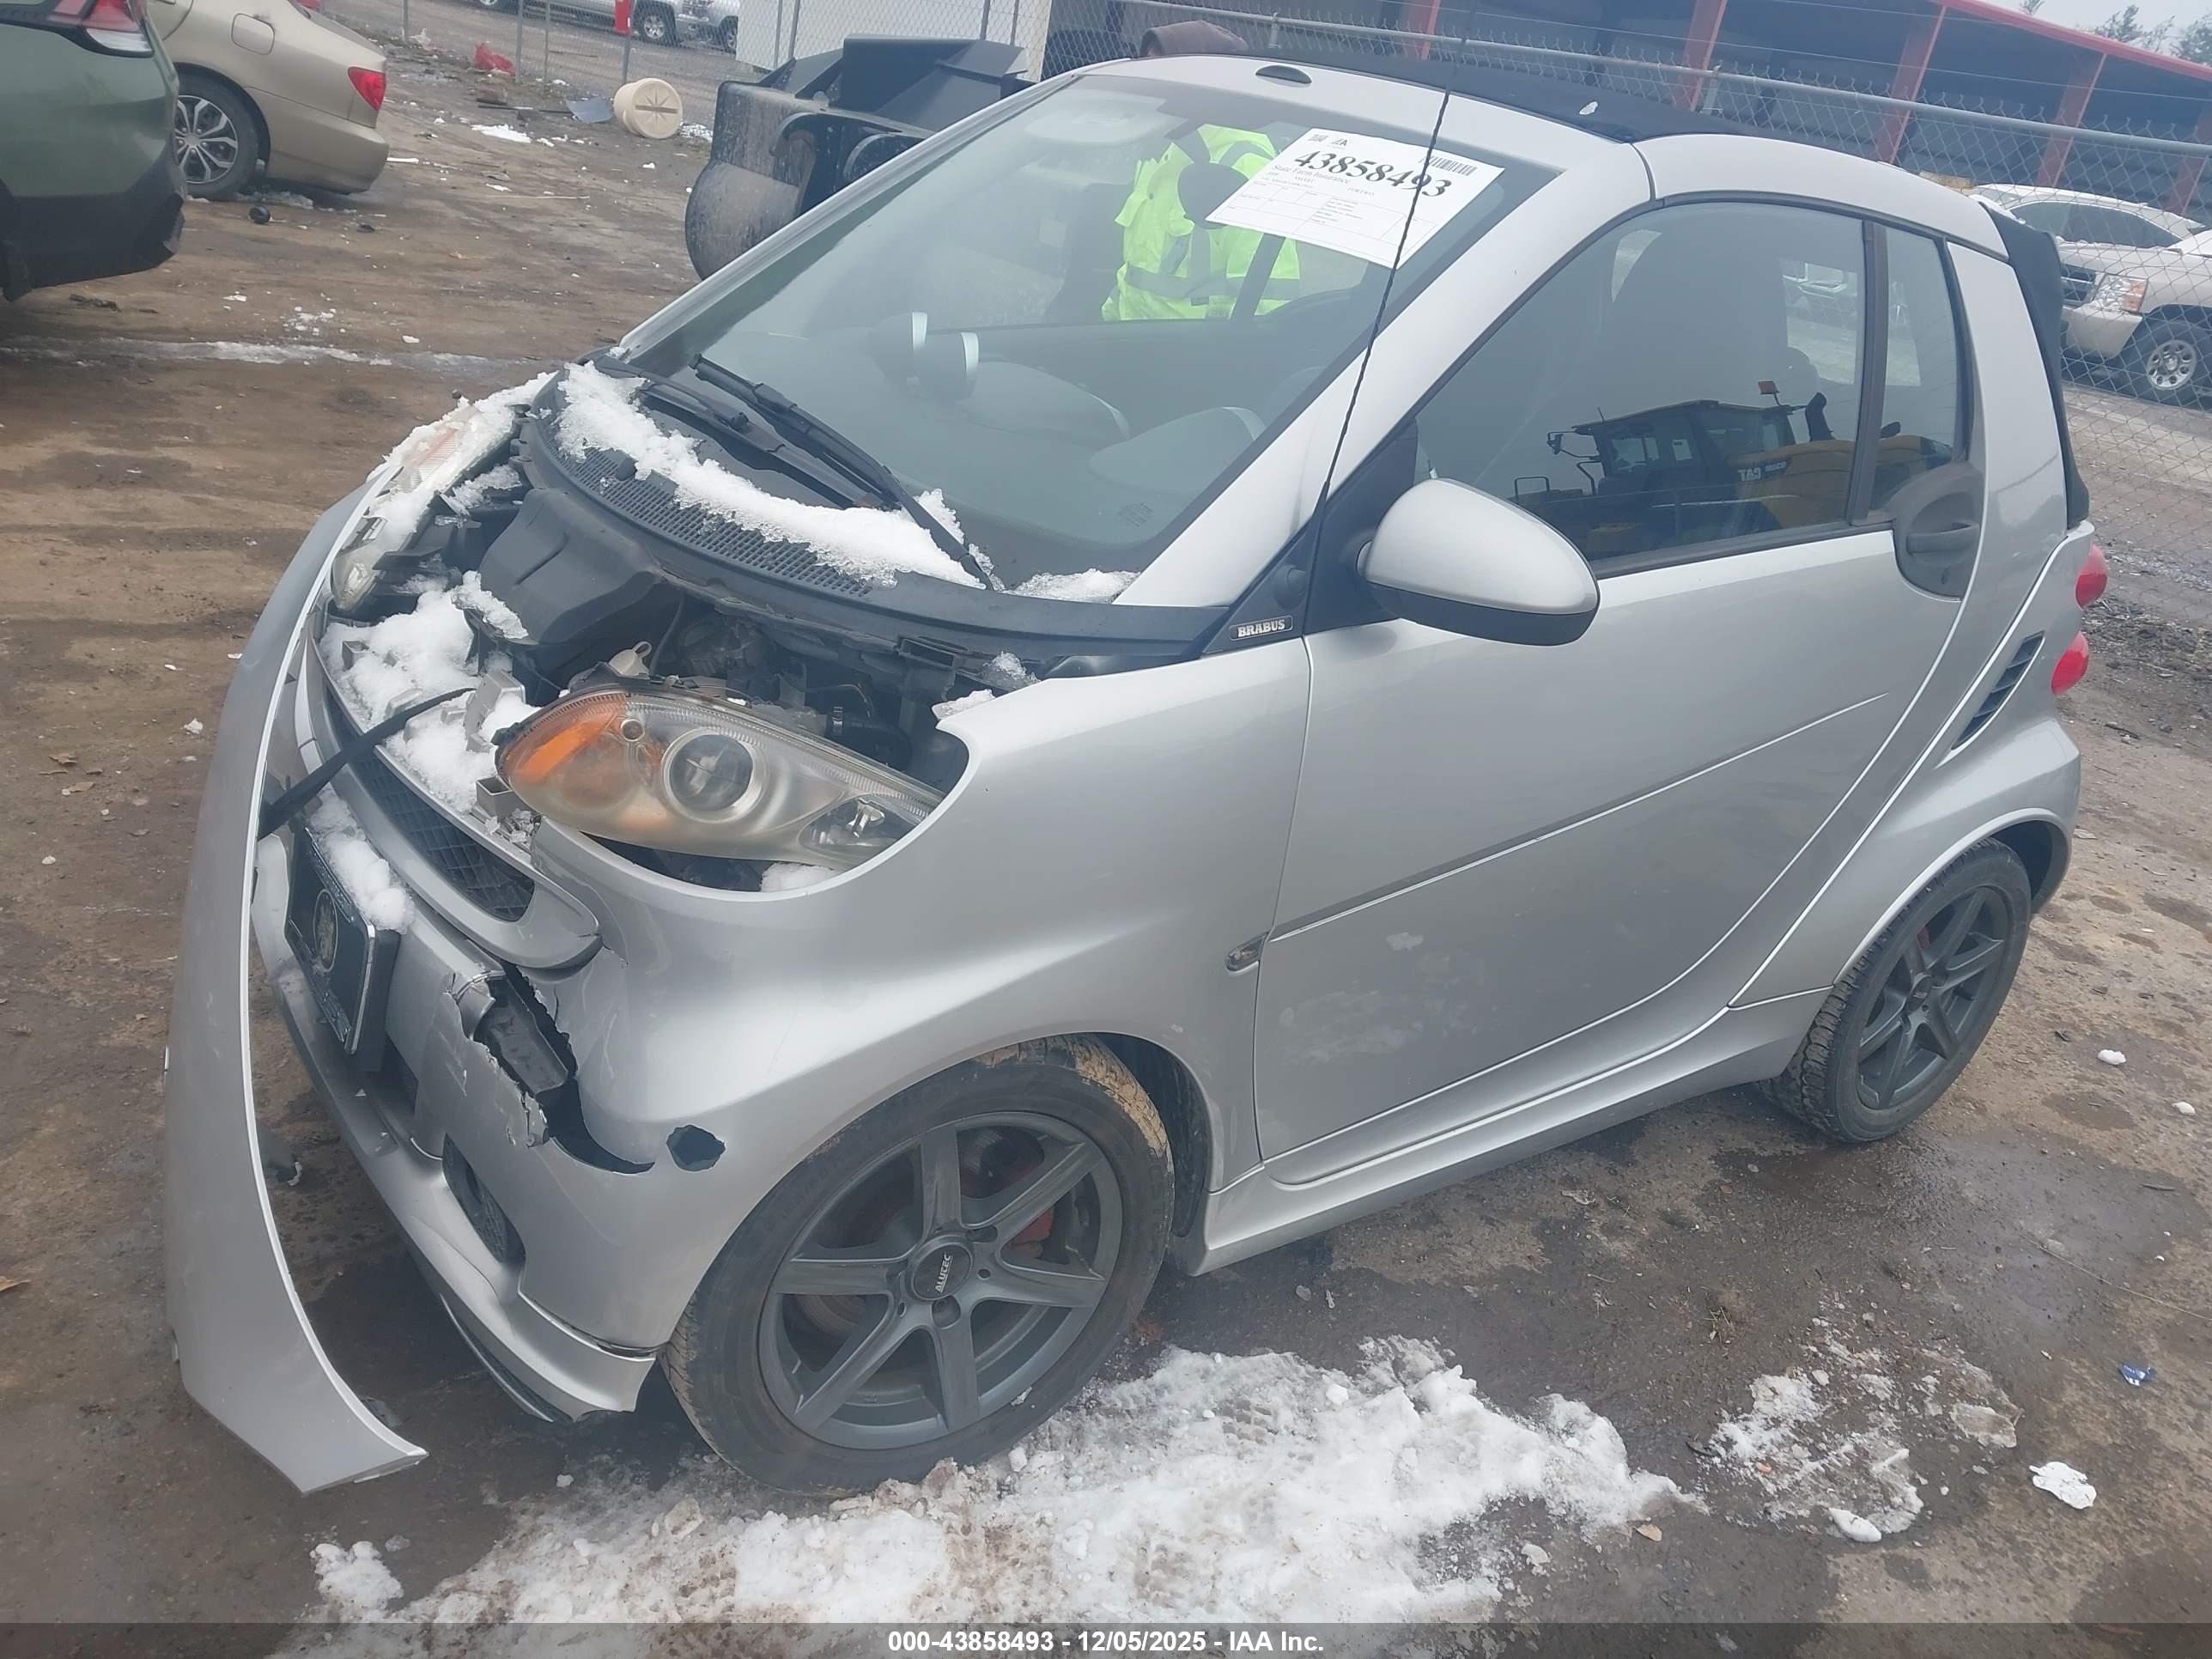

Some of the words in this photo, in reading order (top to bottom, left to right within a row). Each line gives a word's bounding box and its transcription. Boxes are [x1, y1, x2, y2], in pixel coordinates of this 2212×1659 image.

[1294, 150, 1452, 197] 43858493
[1237, 618, 1285, 637] BRABUS
[935, 1254, 951, 1293] ALUTEC
